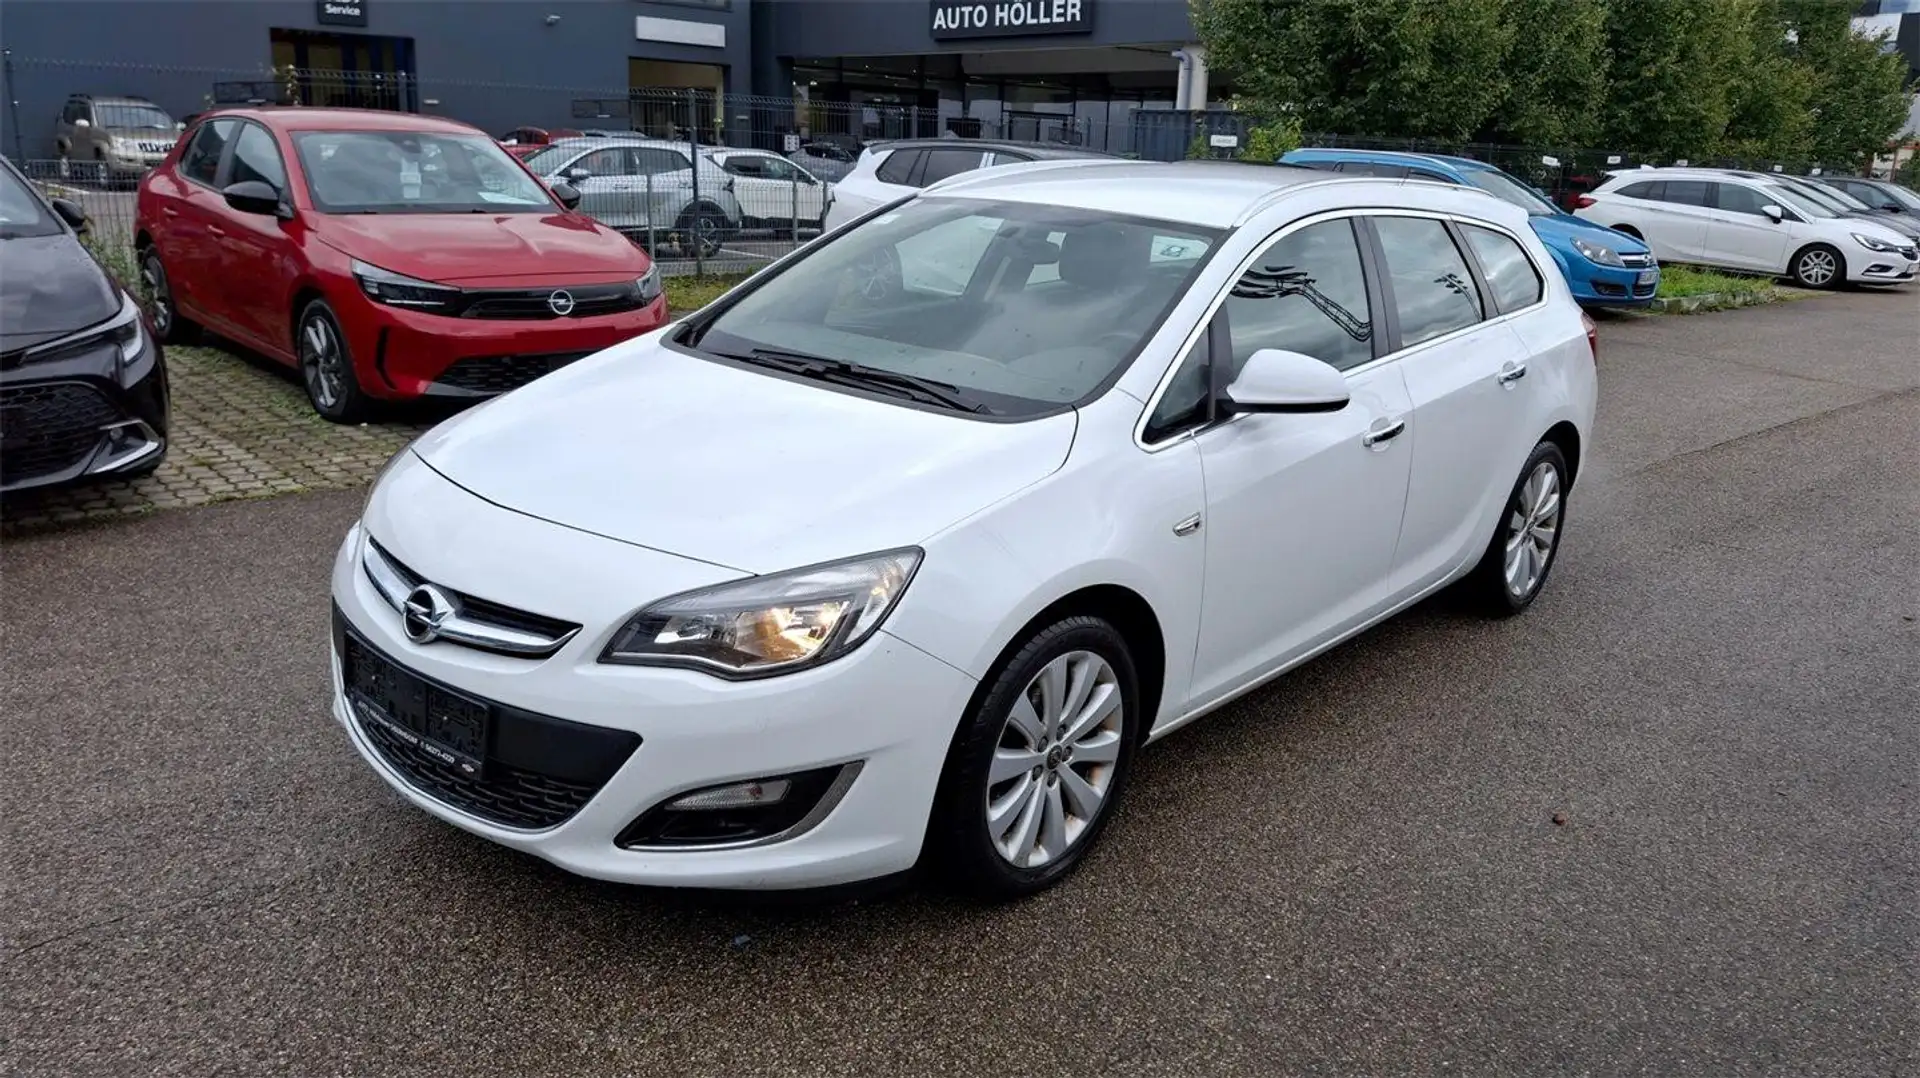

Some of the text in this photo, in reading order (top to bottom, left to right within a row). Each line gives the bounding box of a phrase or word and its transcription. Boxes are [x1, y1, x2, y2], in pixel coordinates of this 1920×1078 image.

[325, 3, 361, 16] Service
[933, 0, 1082, 29] AUTO HÖLLER
